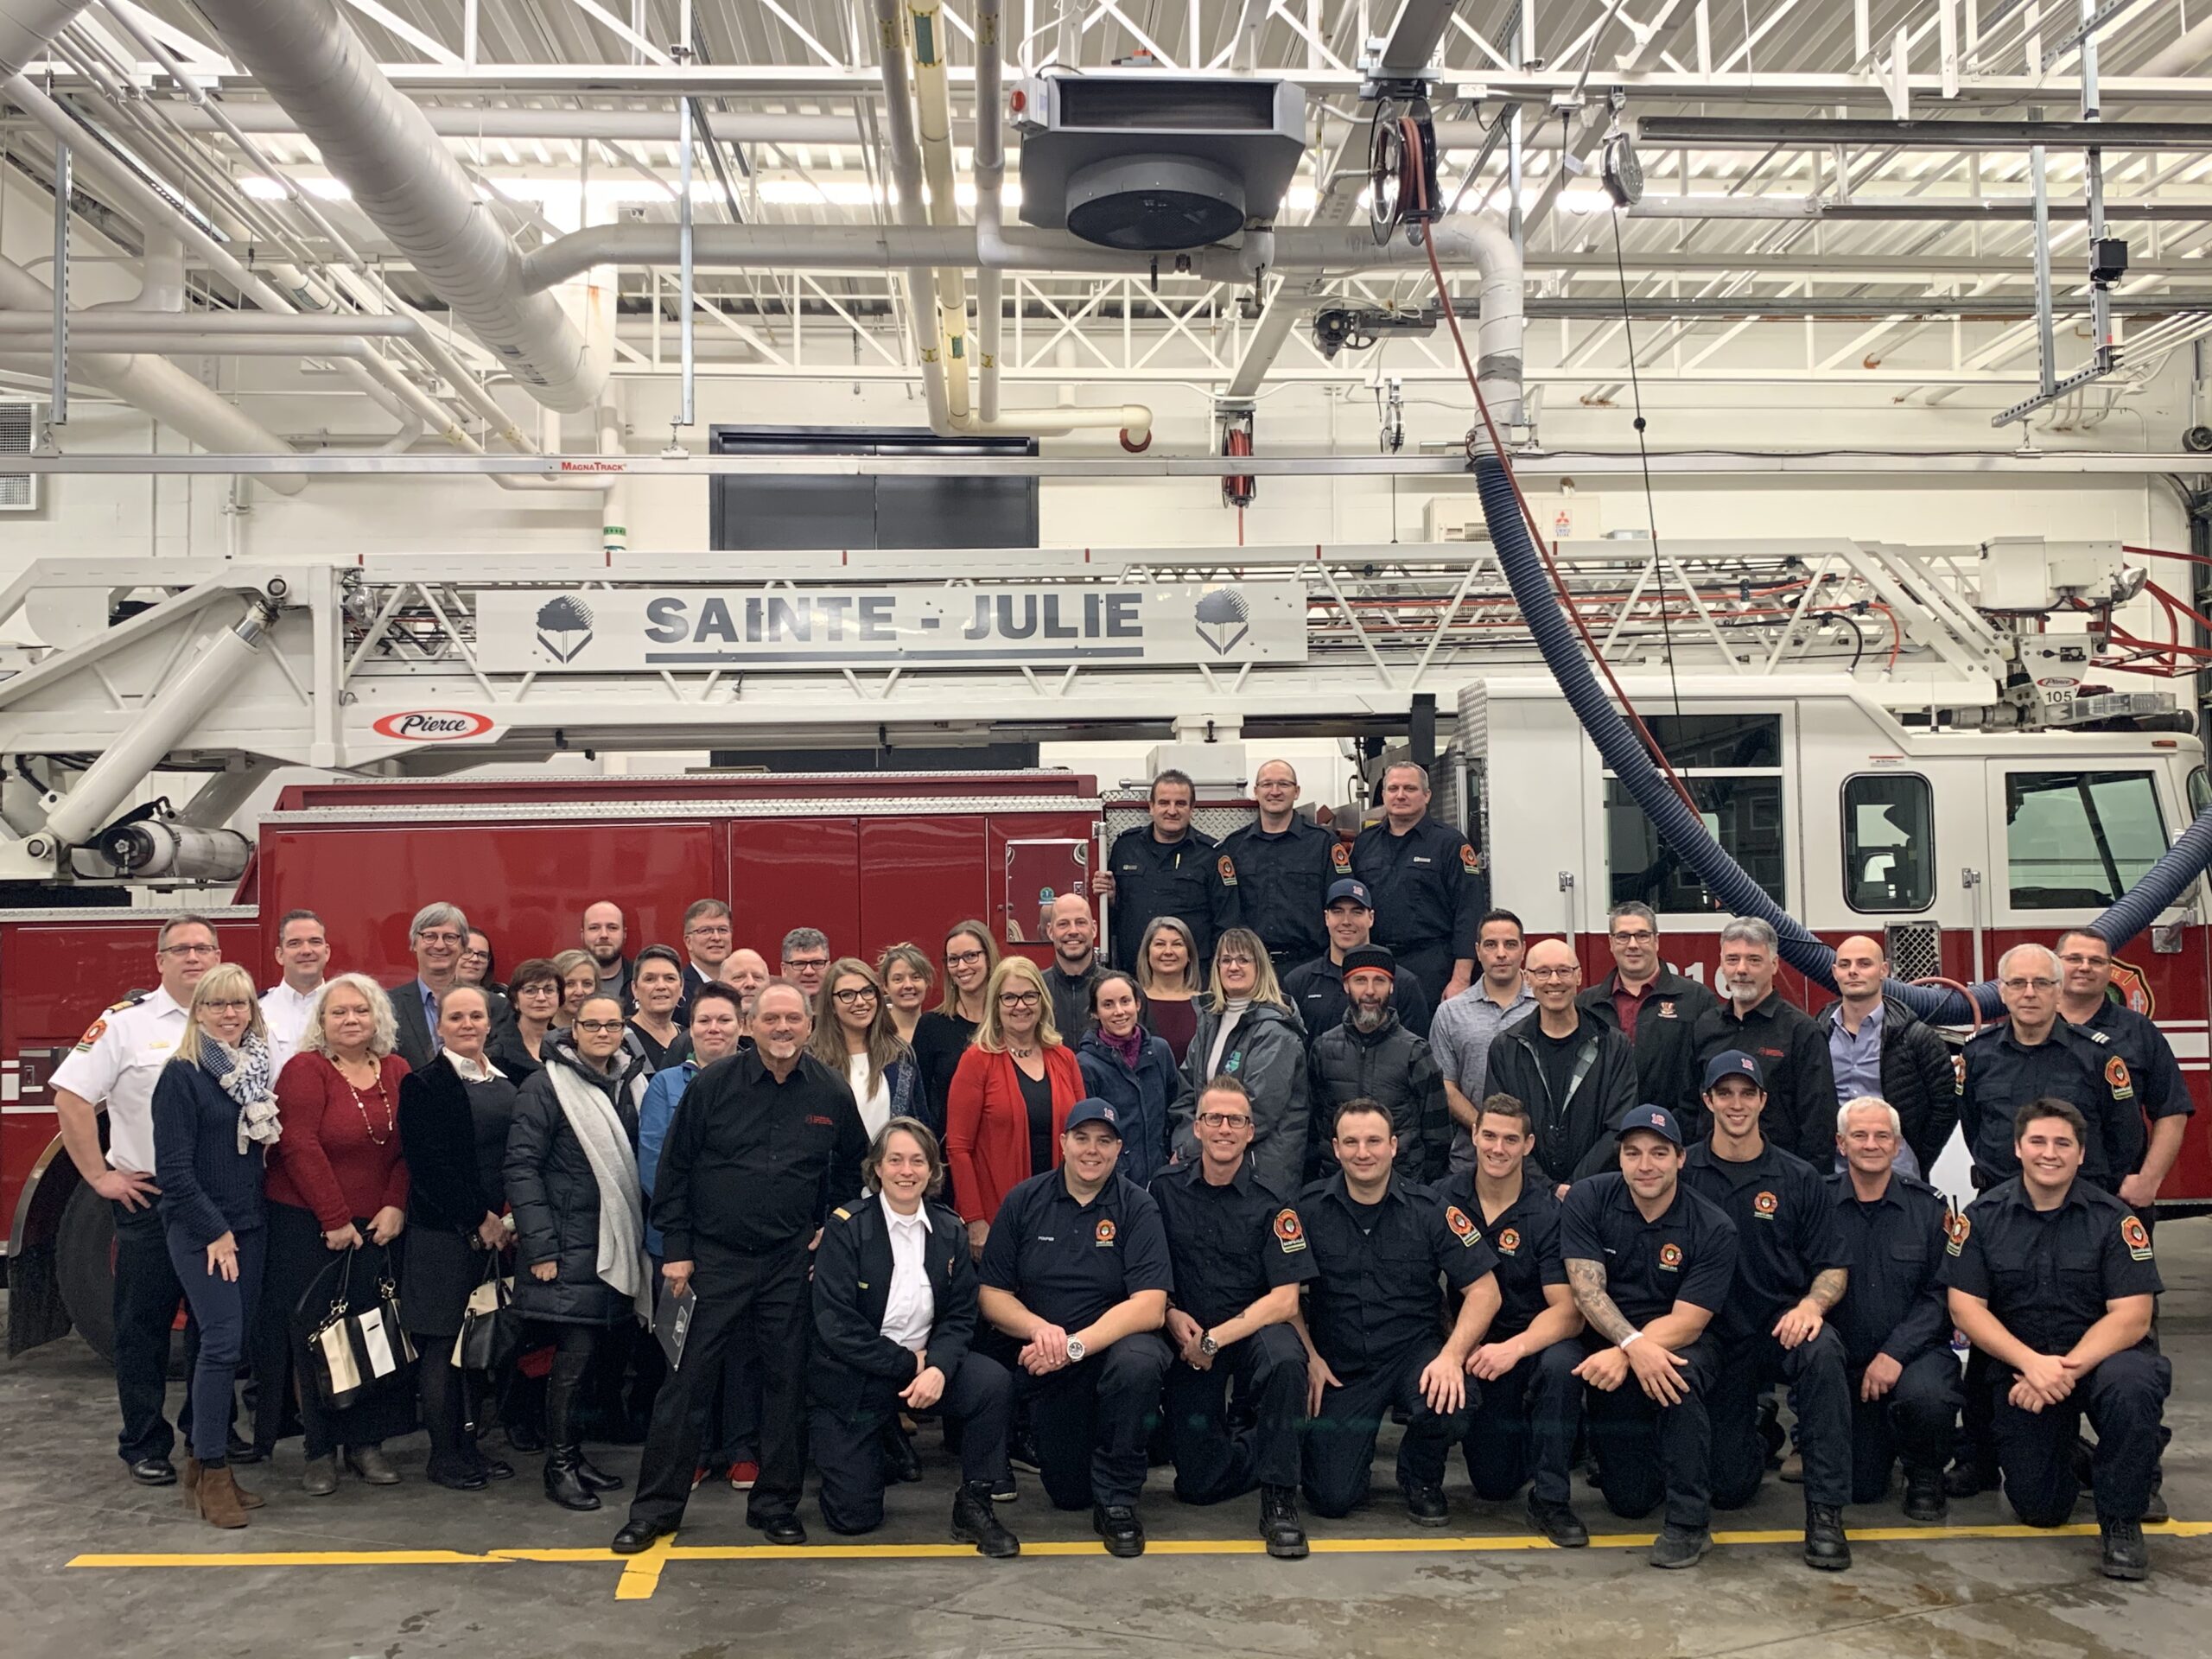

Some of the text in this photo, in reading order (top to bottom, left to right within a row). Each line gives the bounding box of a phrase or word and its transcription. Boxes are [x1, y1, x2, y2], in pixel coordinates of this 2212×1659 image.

[645, 596, 897, 644] SAINTE
[964, 593, 1143, 640] JULIE
[400, 714, 467, 735] Pierce
